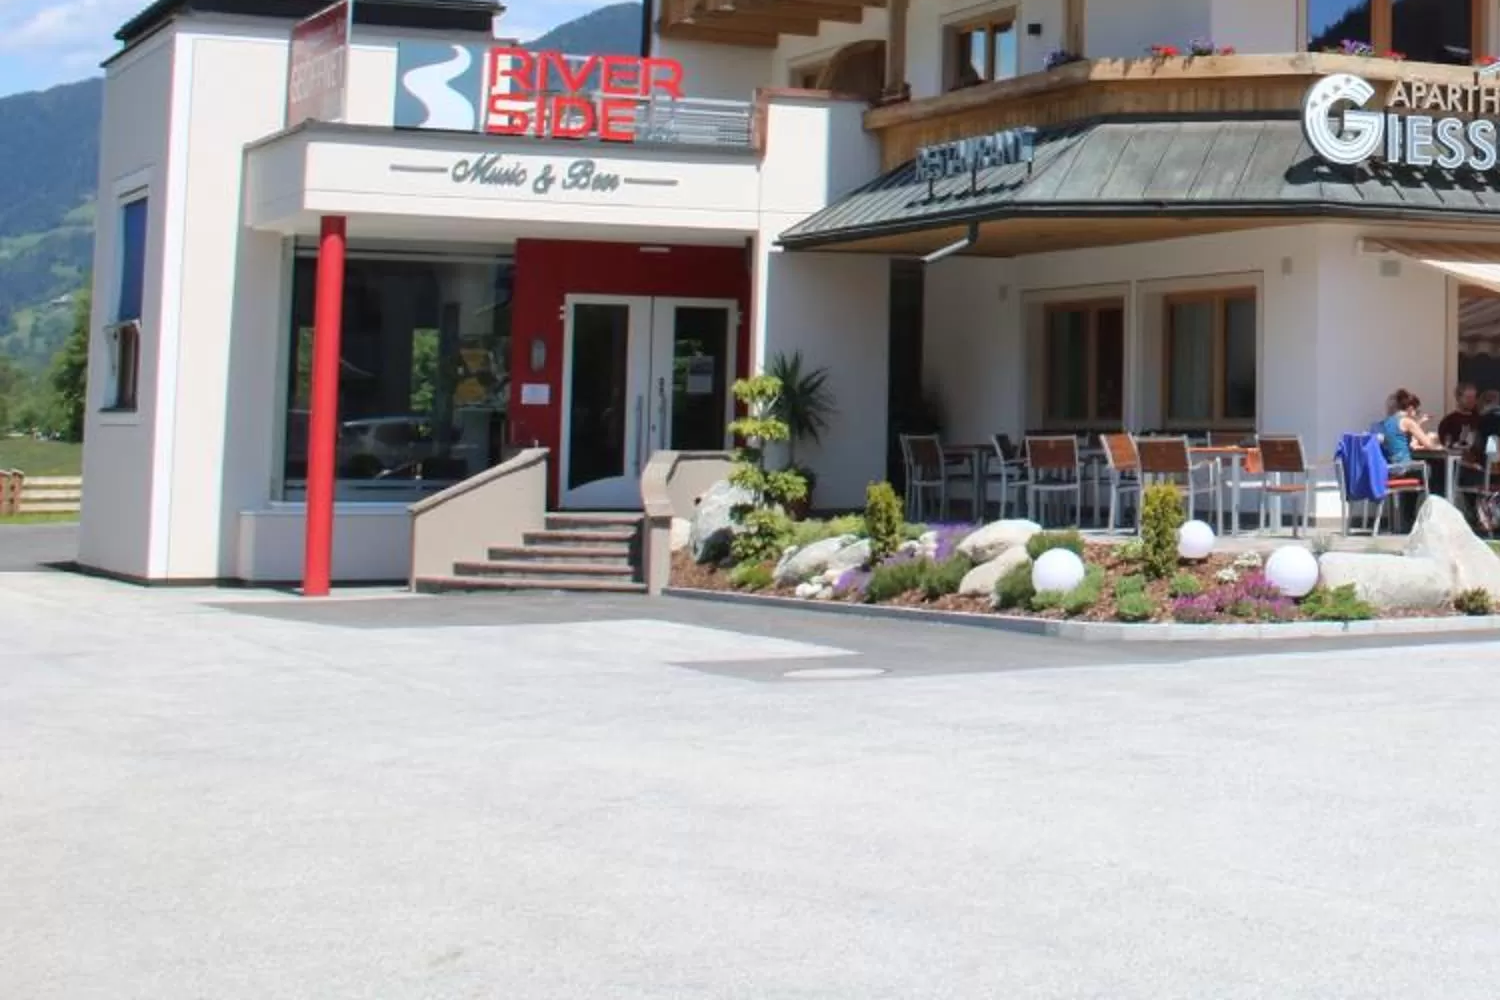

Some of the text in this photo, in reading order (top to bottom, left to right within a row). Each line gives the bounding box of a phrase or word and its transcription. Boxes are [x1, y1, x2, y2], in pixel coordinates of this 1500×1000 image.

[490, 47, 684, 99] RIVER
[486, 94, 636, 143] SIDE
[451, 152, 528, 189] Music
[532, 164, 556, 195] &
